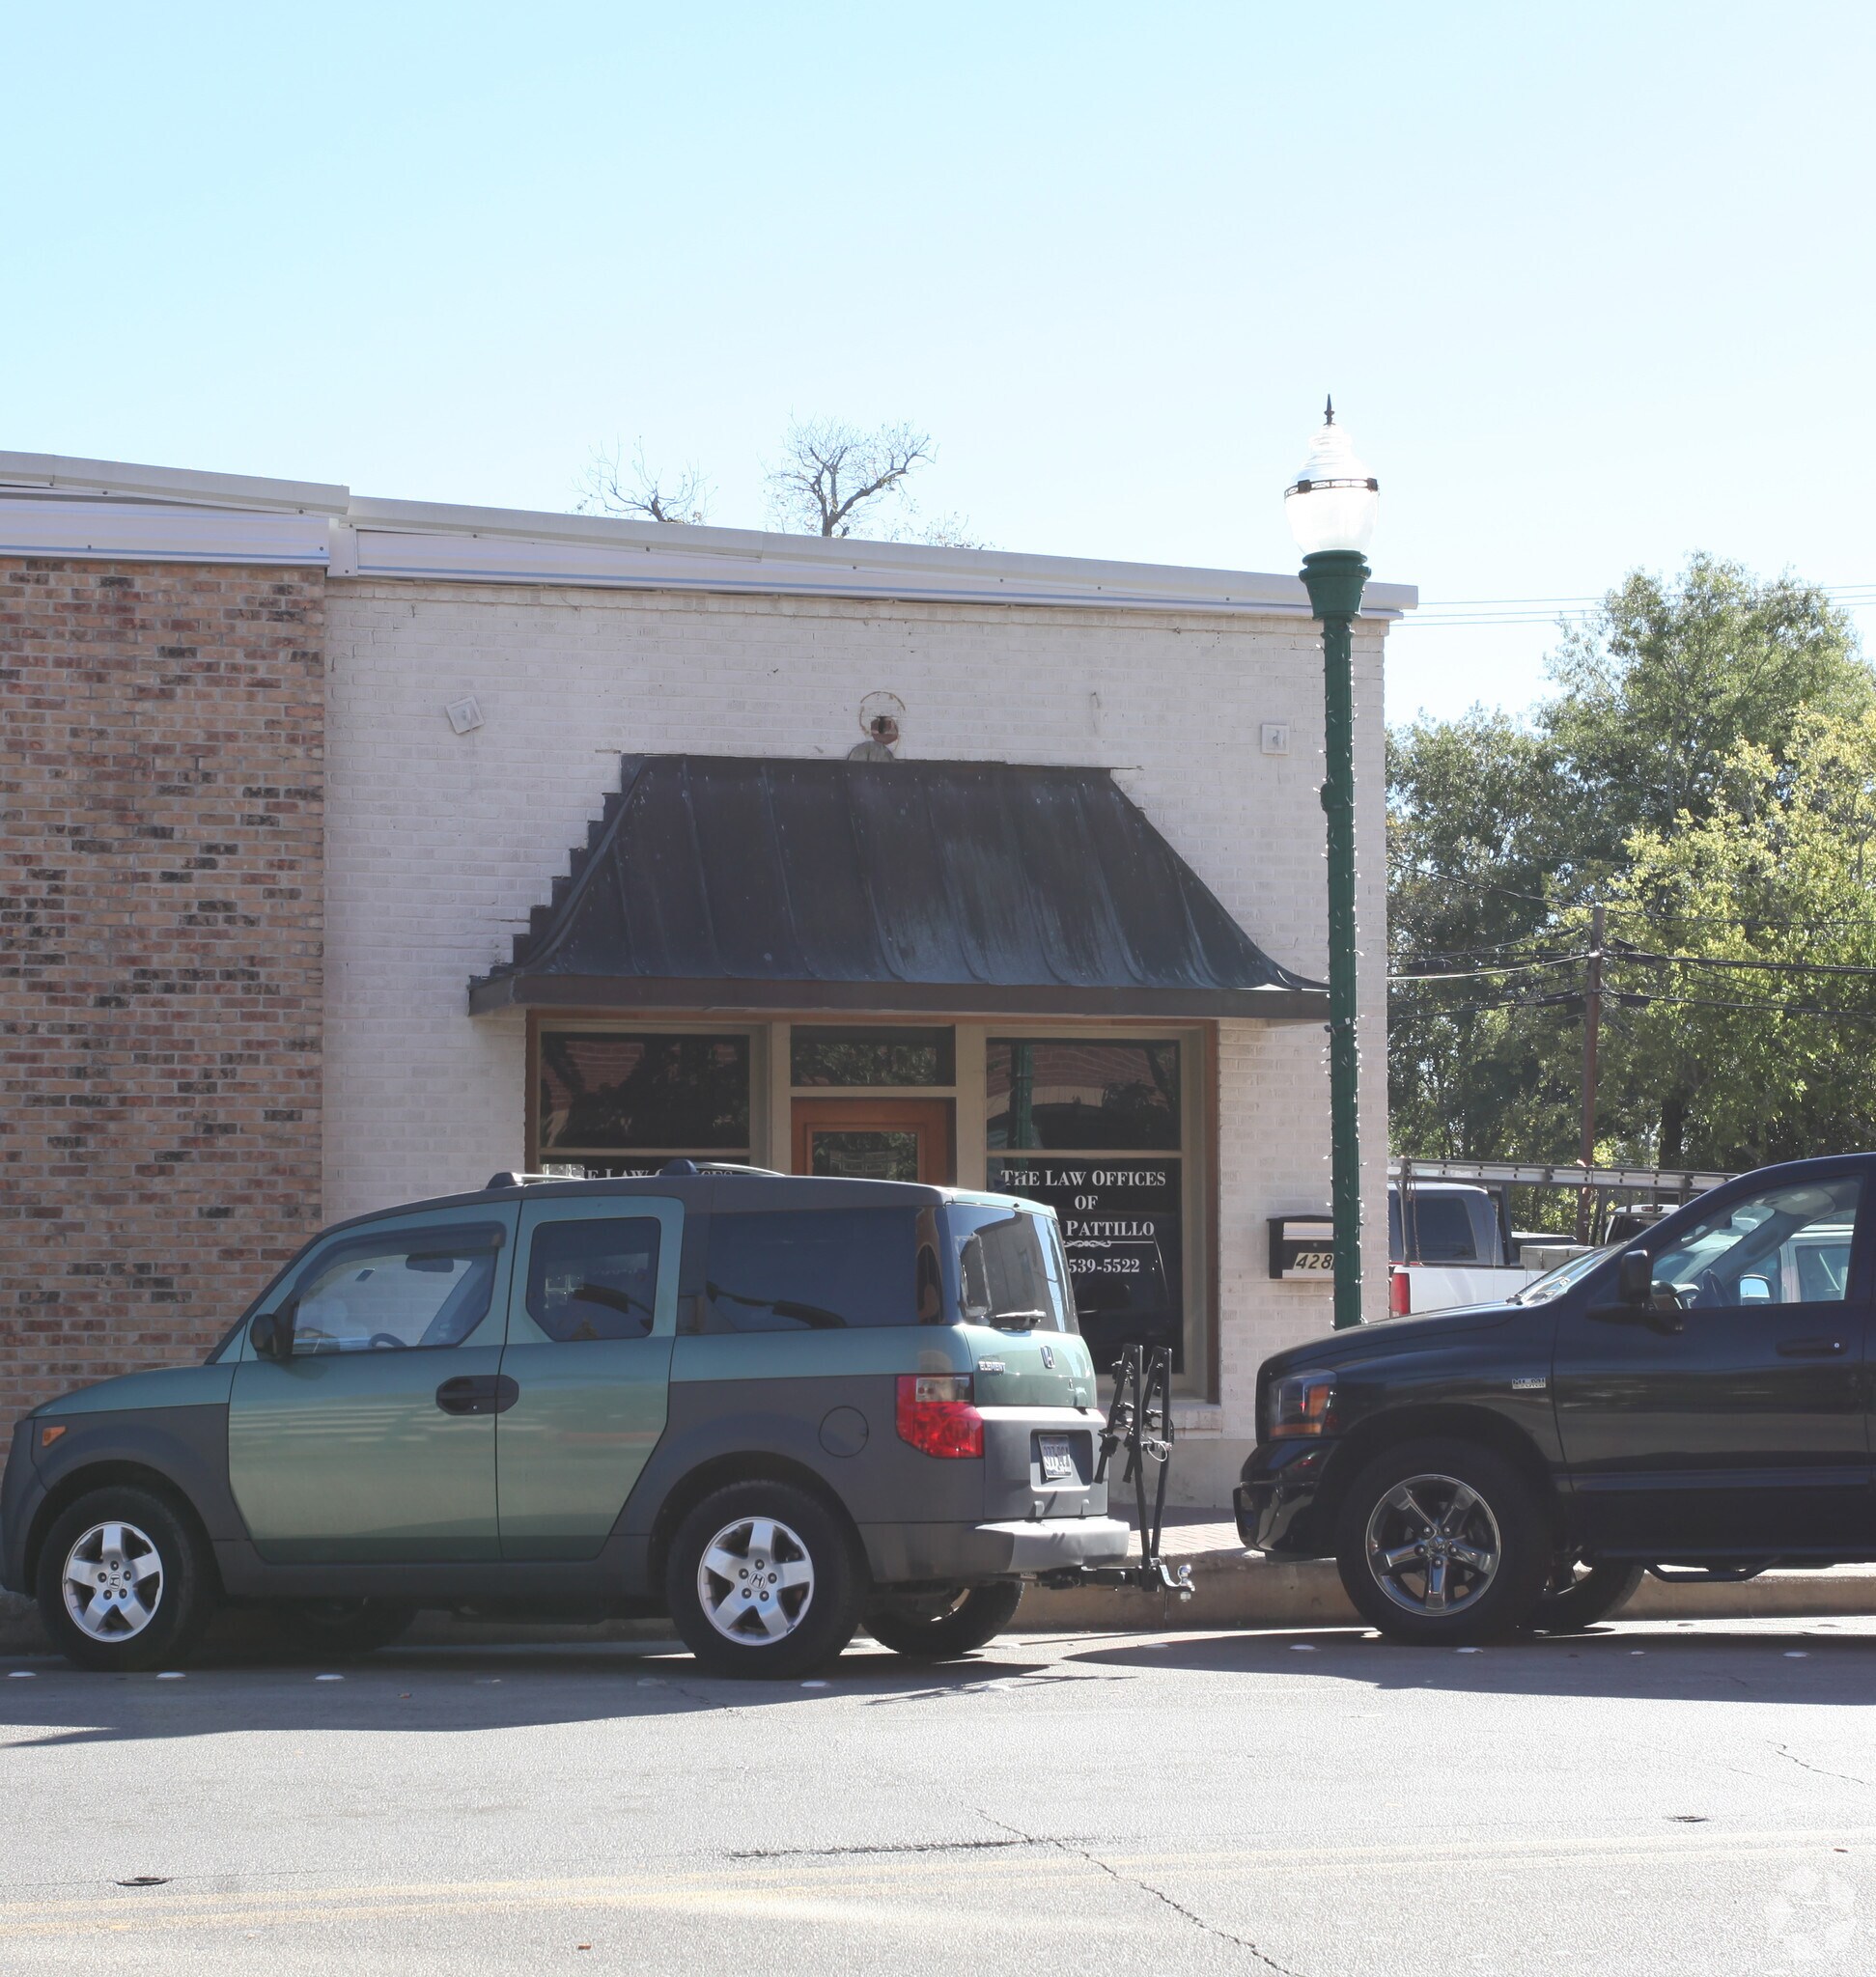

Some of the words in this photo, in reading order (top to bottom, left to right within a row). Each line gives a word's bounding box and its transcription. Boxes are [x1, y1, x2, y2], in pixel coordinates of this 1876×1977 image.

[1001, 1170, 1040, 1185] THE
[1045, 1170, 1087, 1186] LAW
[1092, 1170, 1166, 1186] OFFICES
[1075, 1195, 1099, 1210] OF
[1066, 1220, 1155, 1237] PATTILLO
[1068, 1258, 1140, 1273] 539-5522
[1295, 1254, 1332, 1269] 428
[978, 1360, 1006, 1373] ELEMENT
